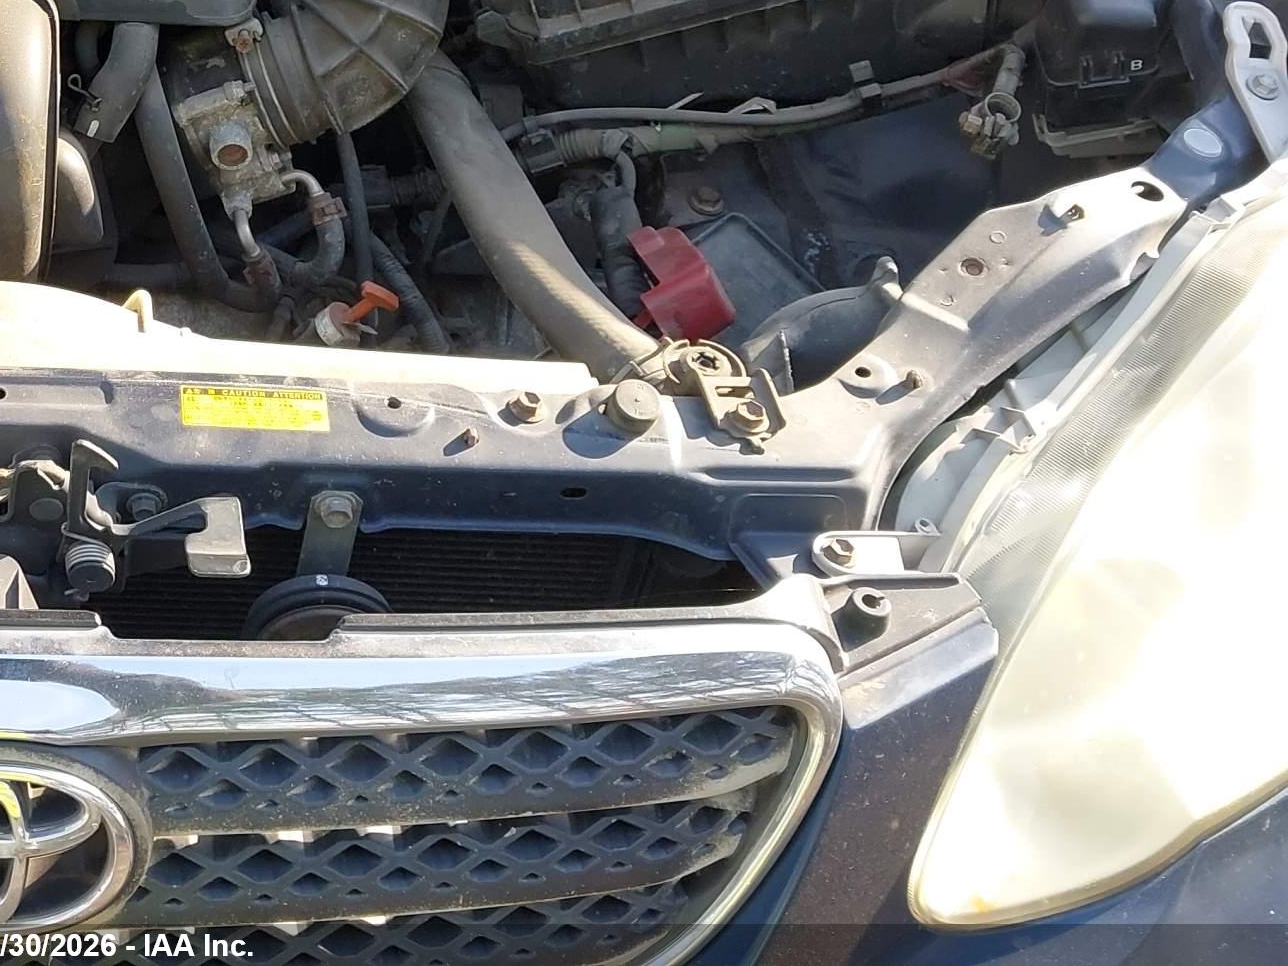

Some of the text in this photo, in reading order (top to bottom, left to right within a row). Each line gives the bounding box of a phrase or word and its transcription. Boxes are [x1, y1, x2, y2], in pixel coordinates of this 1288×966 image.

[1130, 59, 1144, 71] B
[222, 389, 321, 400] CAUTION ATTENTION
